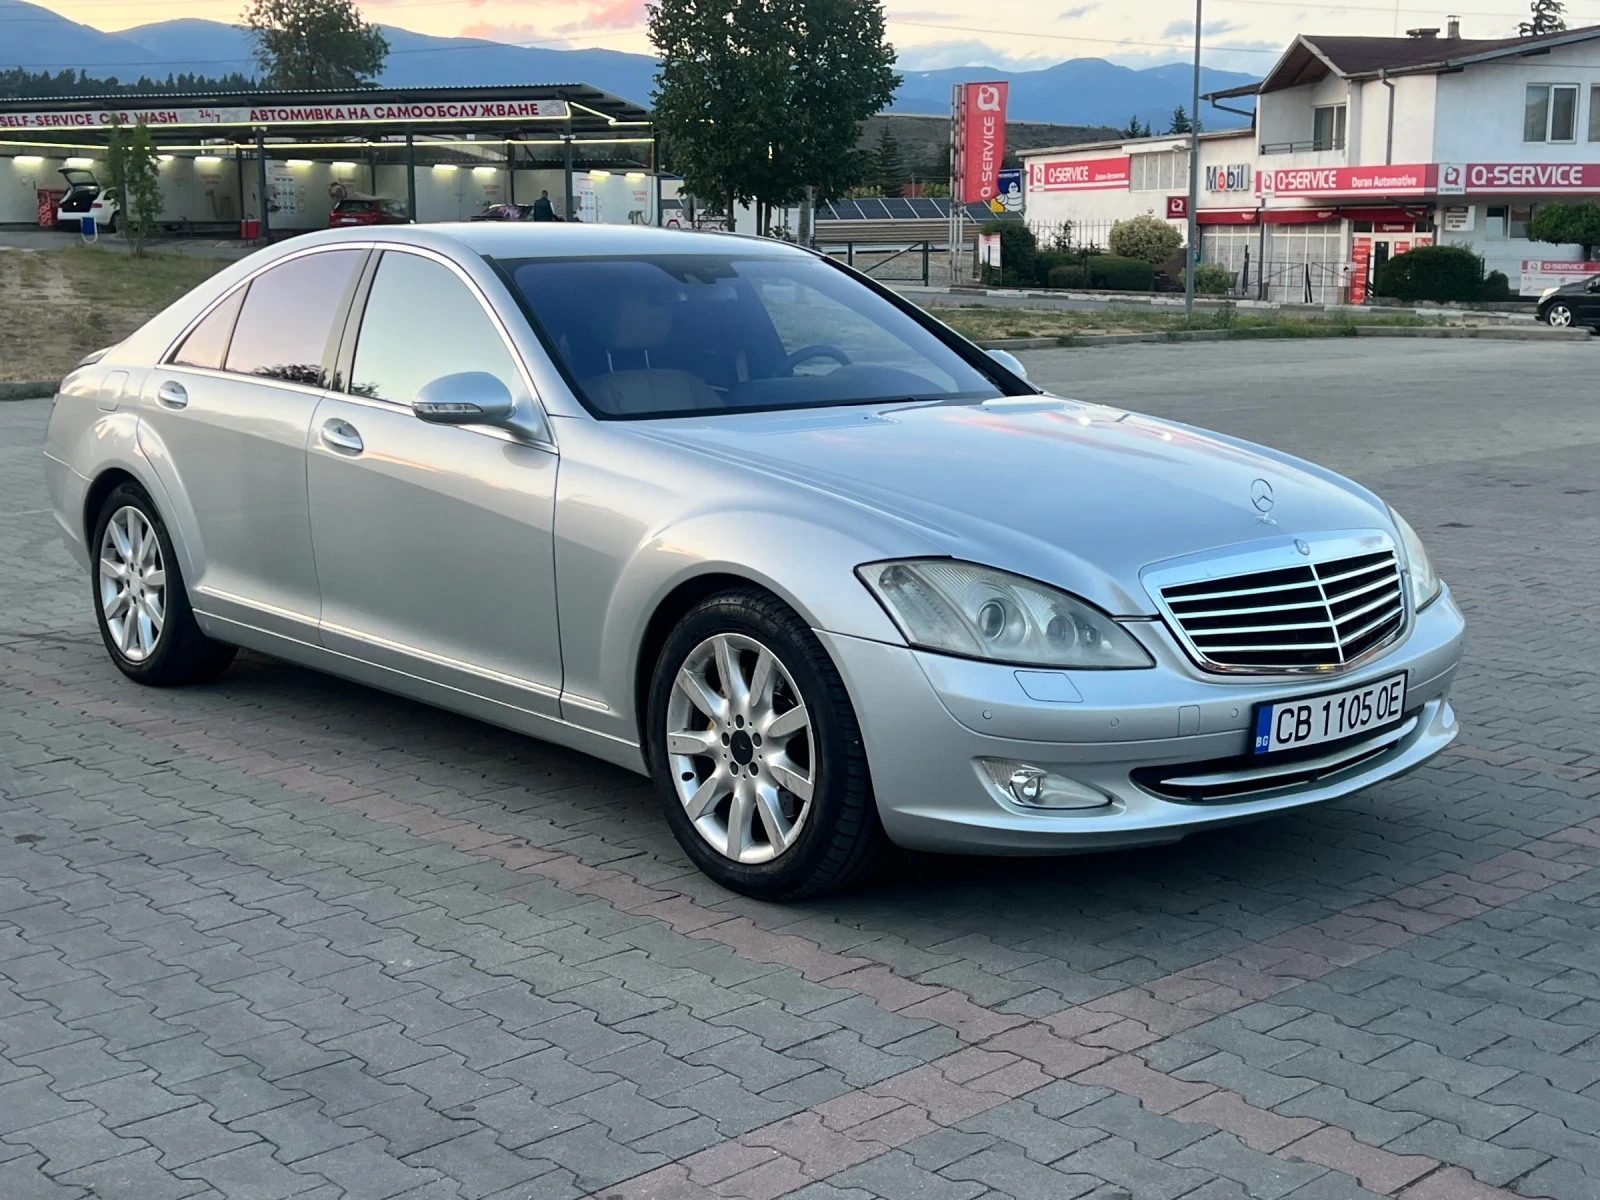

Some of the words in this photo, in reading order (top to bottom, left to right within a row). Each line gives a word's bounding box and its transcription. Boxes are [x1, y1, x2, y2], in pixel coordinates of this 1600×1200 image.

[0, 113, 94, 127] SELF-SERVICE
[99, 112, 130, 125] CR
[133, 111, 179, 124] WASH
[198, 109, 221, 123] 24/7
[250, 108, 345, 121] АВТОМИВКА
[348, 107, 371, 119] НА
[373, 103, 539, 119] САМООБСЛУЖВАНЕ
[1048, 166, 1089, 183] Q-SERVICE
[1205, 164, 1244, 191] Mobil
[1277, 170, 1337, 189] Q-SERVICE
[1351, 176, 1372, 188] Duran
[1373, 174, 1417, 187] Automotive
[1471, 165, 1583, 185] Q-SERVICE
[1322, 690, 1374, 736] 1105
[1256, 735, 1269, 748] BG
